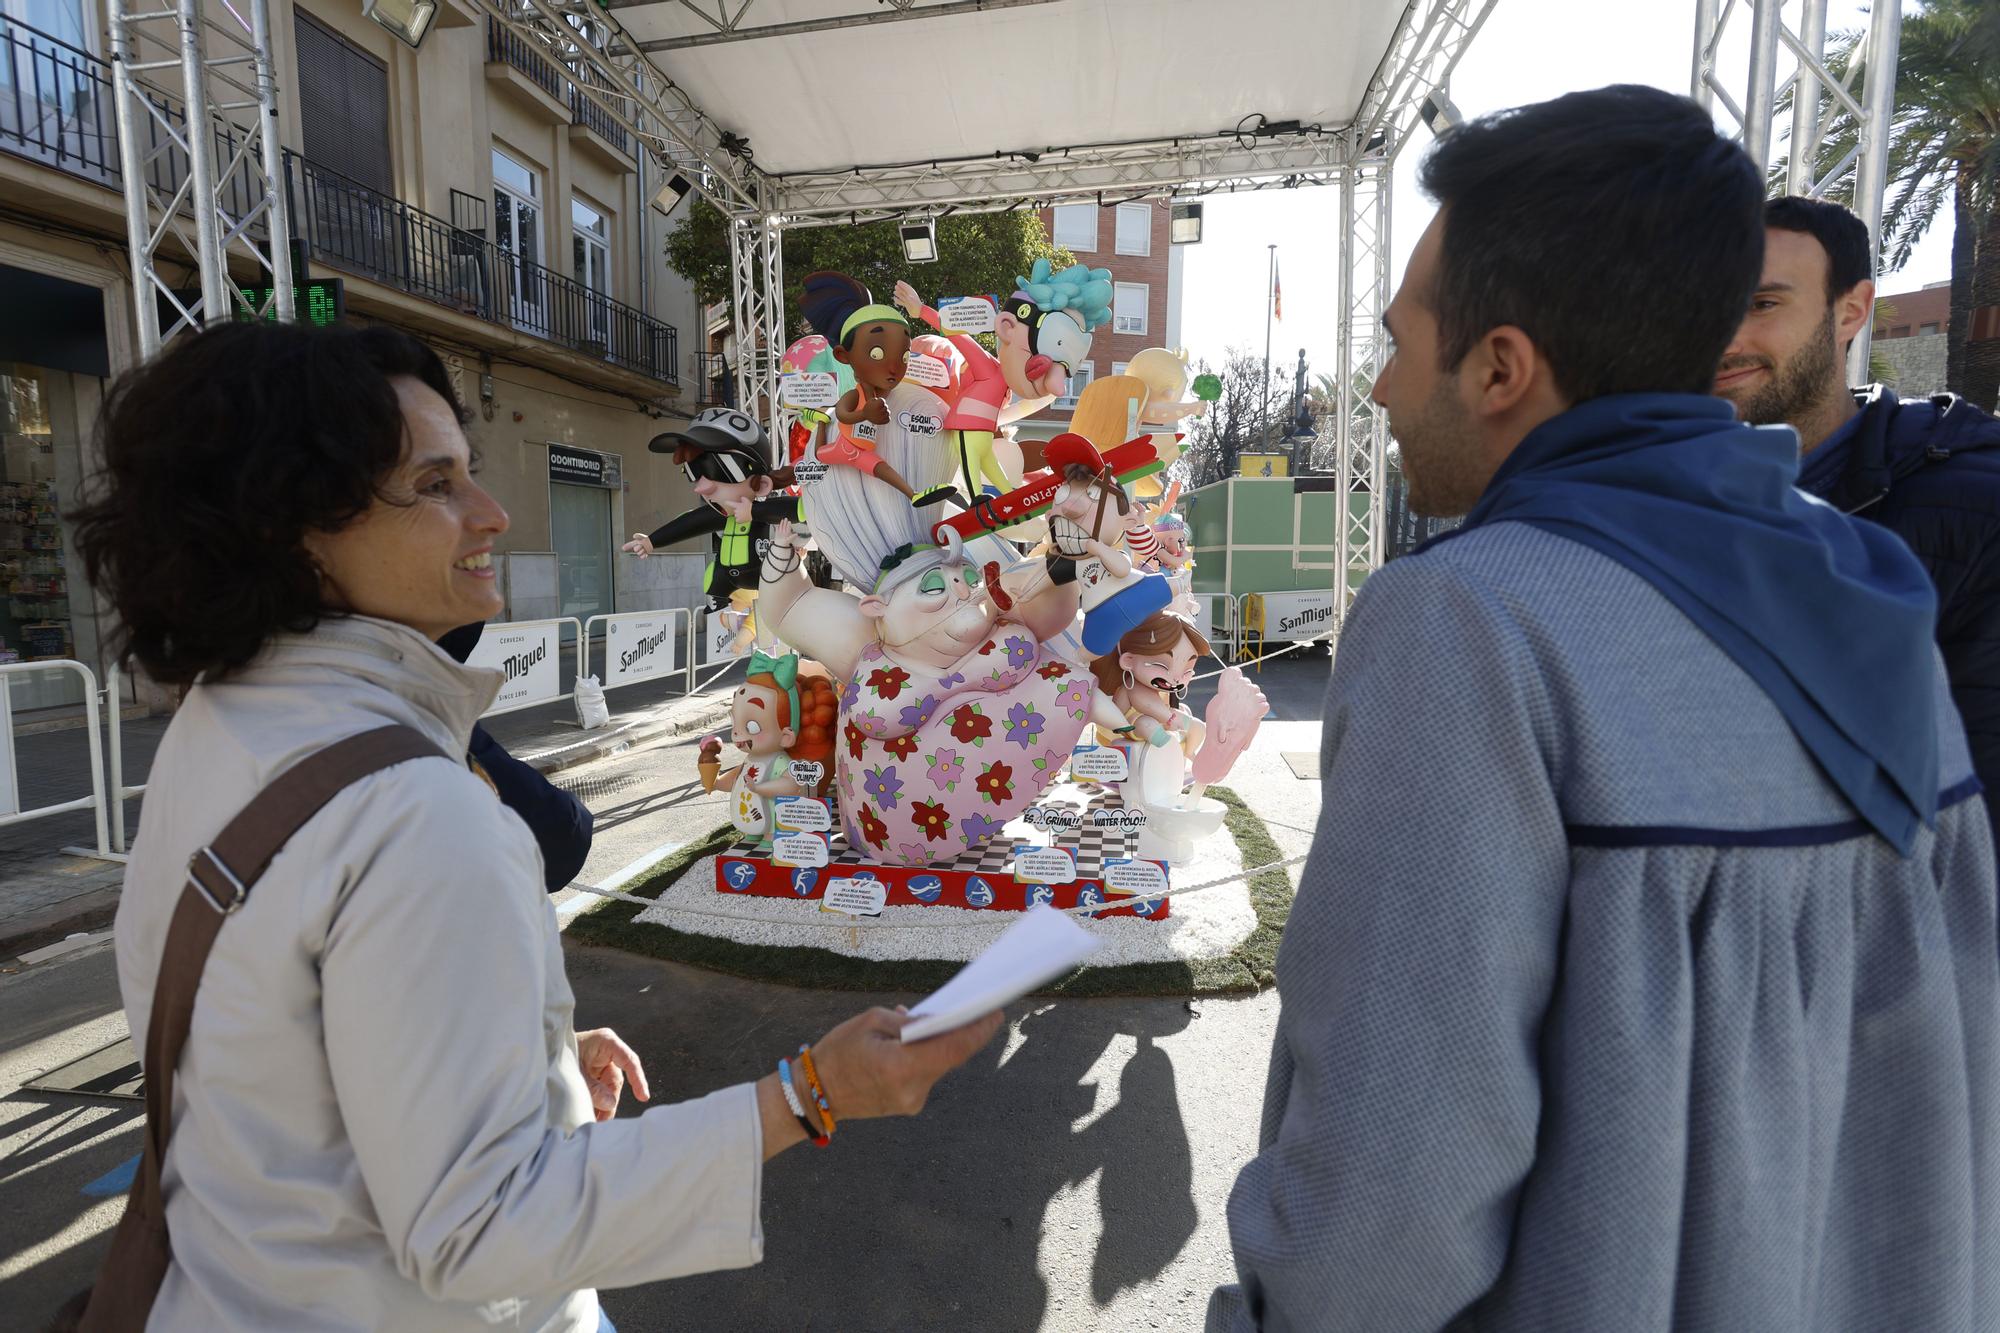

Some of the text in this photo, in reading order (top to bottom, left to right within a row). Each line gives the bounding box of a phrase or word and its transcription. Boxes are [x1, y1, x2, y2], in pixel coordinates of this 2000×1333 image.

[551, 454, 600, 471] ODONTIWORLD
[1278, 607, 1332, 632] SanMigu
[500, 636, 525, 645] CERVEZAS
[499, 693, 514, 701] SINCE
